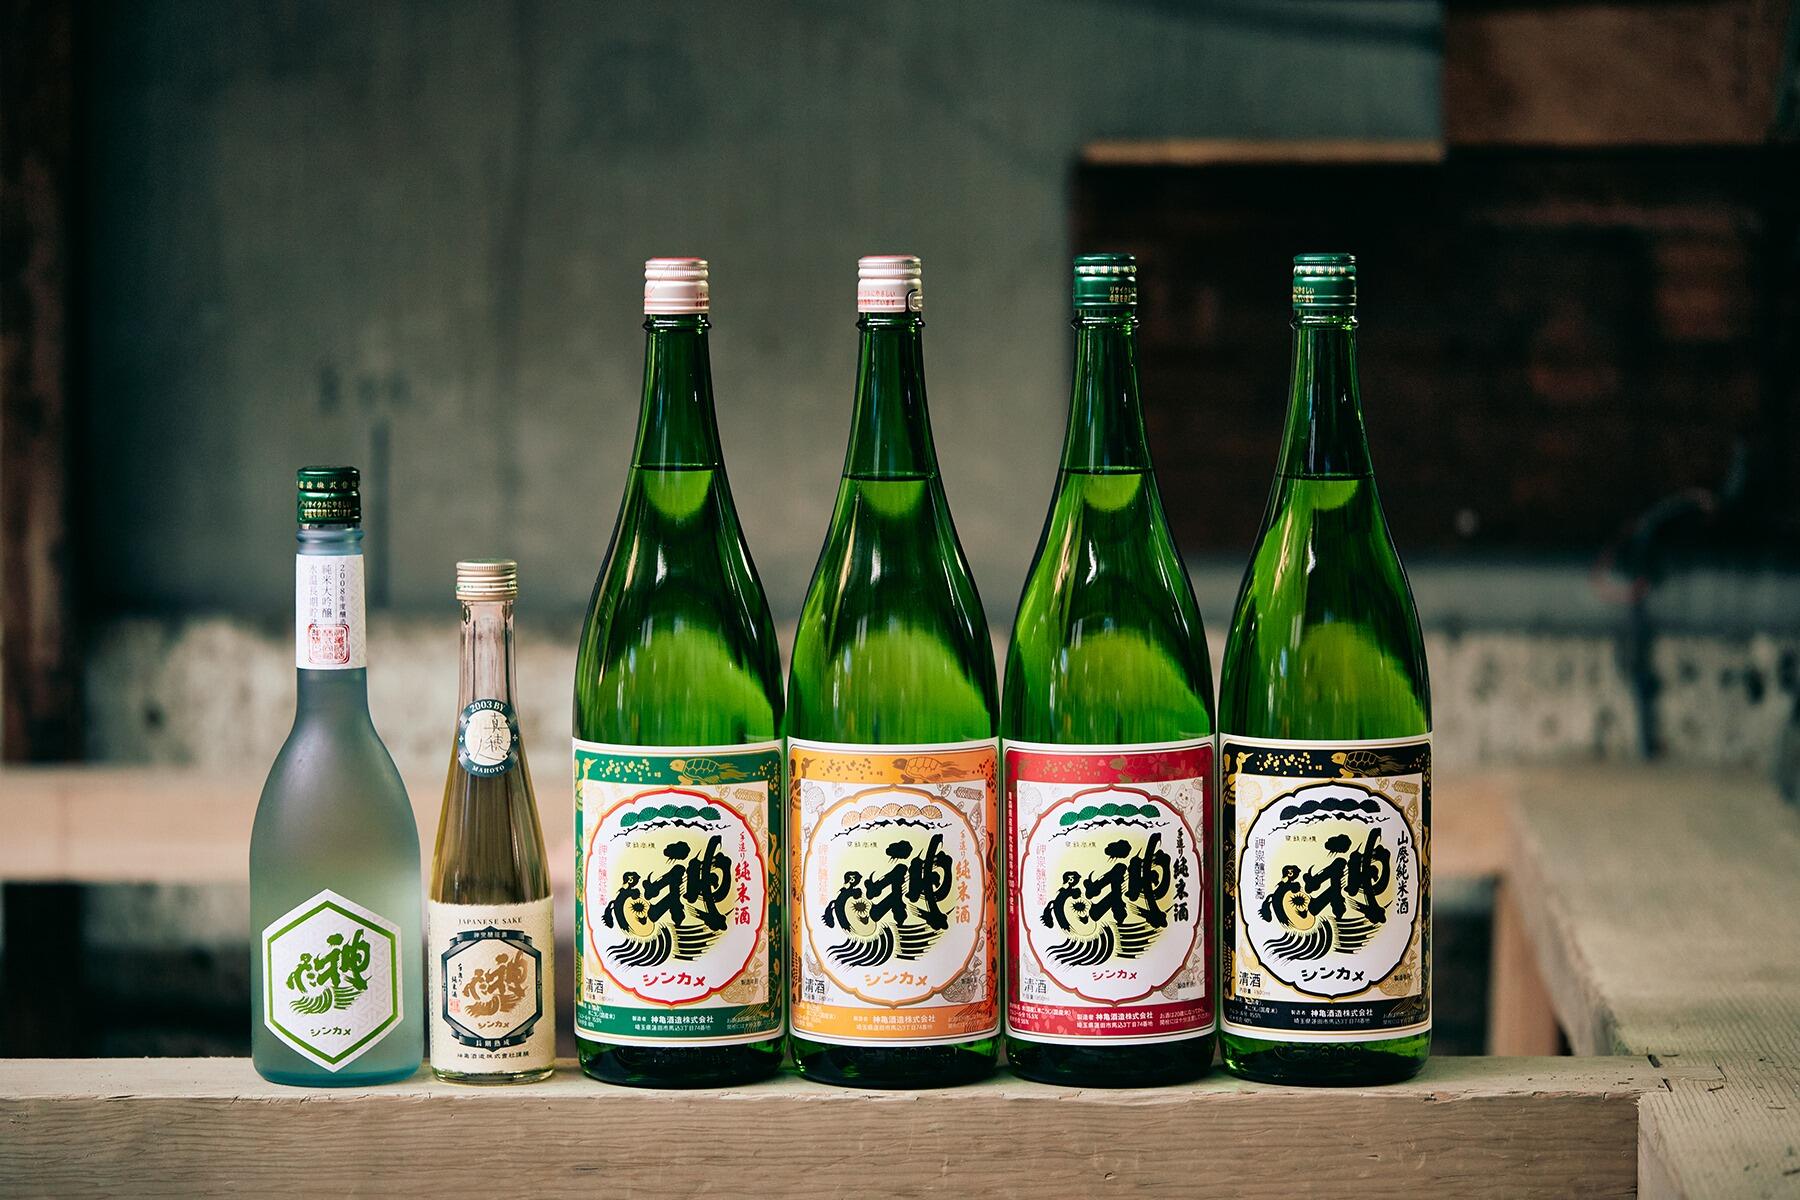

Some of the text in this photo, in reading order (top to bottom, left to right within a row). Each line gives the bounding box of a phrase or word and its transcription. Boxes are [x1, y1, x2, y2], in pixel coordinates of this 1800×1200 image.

[470, 701, 505, 713] 2003 BY
[1396, 830, 1409, 915] 山廃純米酒
[457, 916, 522, 926] JAPANESE SAKE
[642, 972, 706, 987] シンカメ
[865, 971, 928, 987] シンカメ
[1093, 968, 1138, 981] シンカメ
[1239, 971, 1261, 988] 清酒
[1302, 967, 1365, 982] シンカメ
[586, 978, 604, 993] 清酒
[805, 978, 825, 994] 清酒
[1024, 977, 1047, 993] 清酒
[651, 1015, 714, 1025] 神亀酒造株式会社
[1095, 1010, 1153, 1021] 神亀酒造株式会社
[311, 1026, 351, 1037] シンカメ
[478, 1020, 510, 1029] シンカメ
